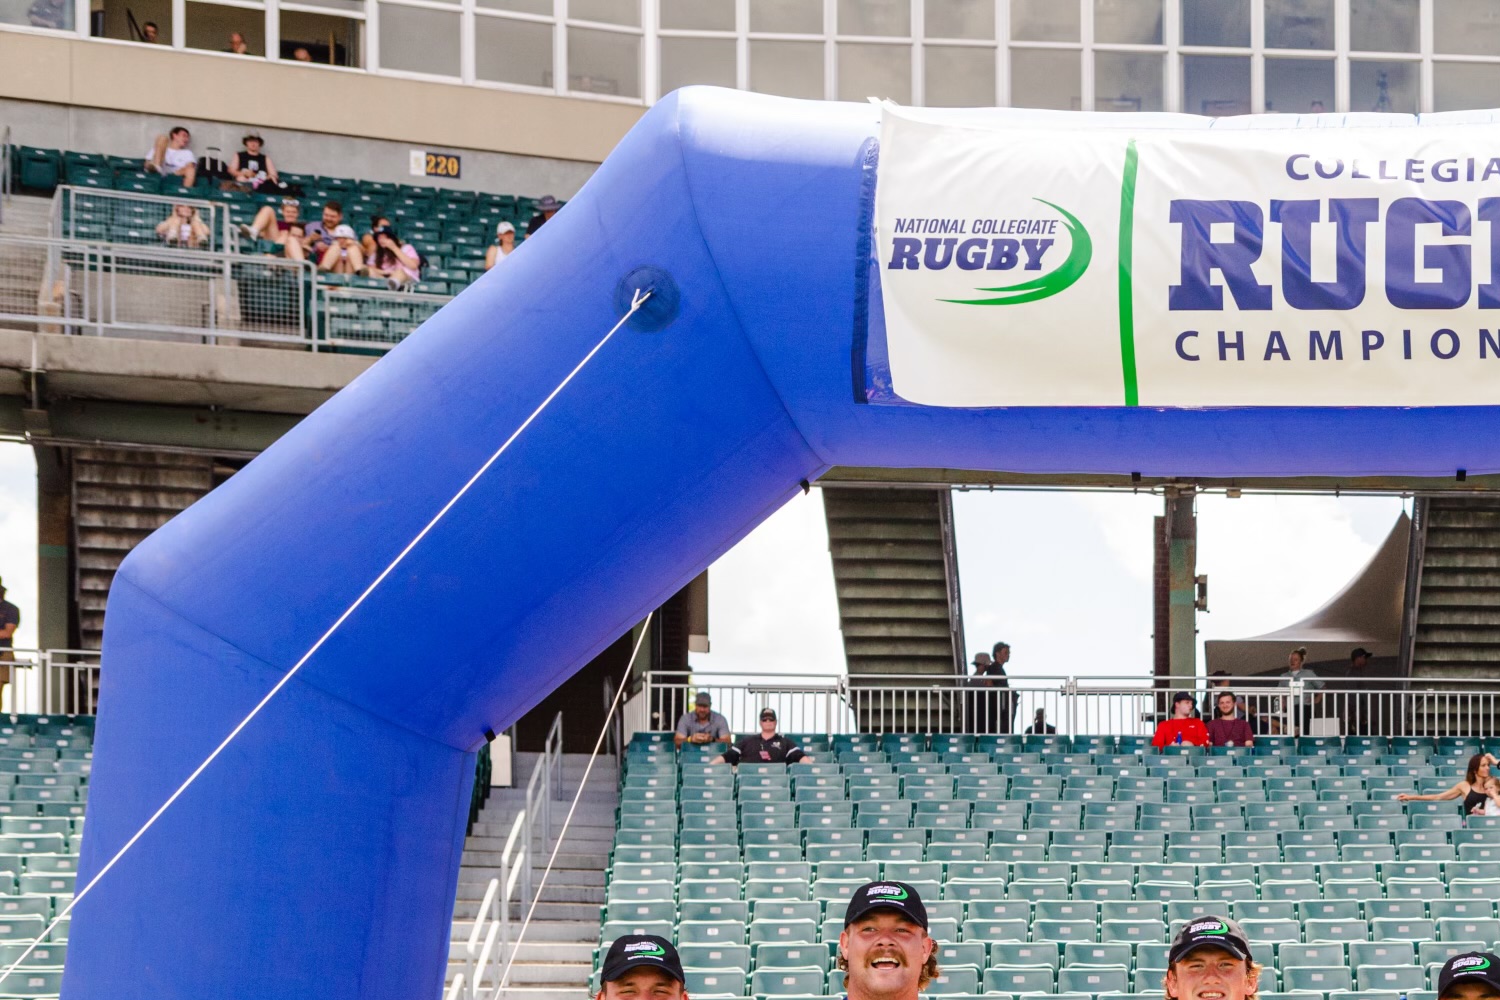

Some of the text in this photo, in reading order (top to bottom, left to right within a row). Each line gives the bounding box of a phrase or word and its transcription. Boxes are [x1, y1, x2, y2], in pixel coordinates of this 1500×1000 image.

[426, 154, 459, 176] 220
[894, 217, 1058, 235] NATIONAL COLLEGIATE
[888, 237, 1055, 271] RUGBY
